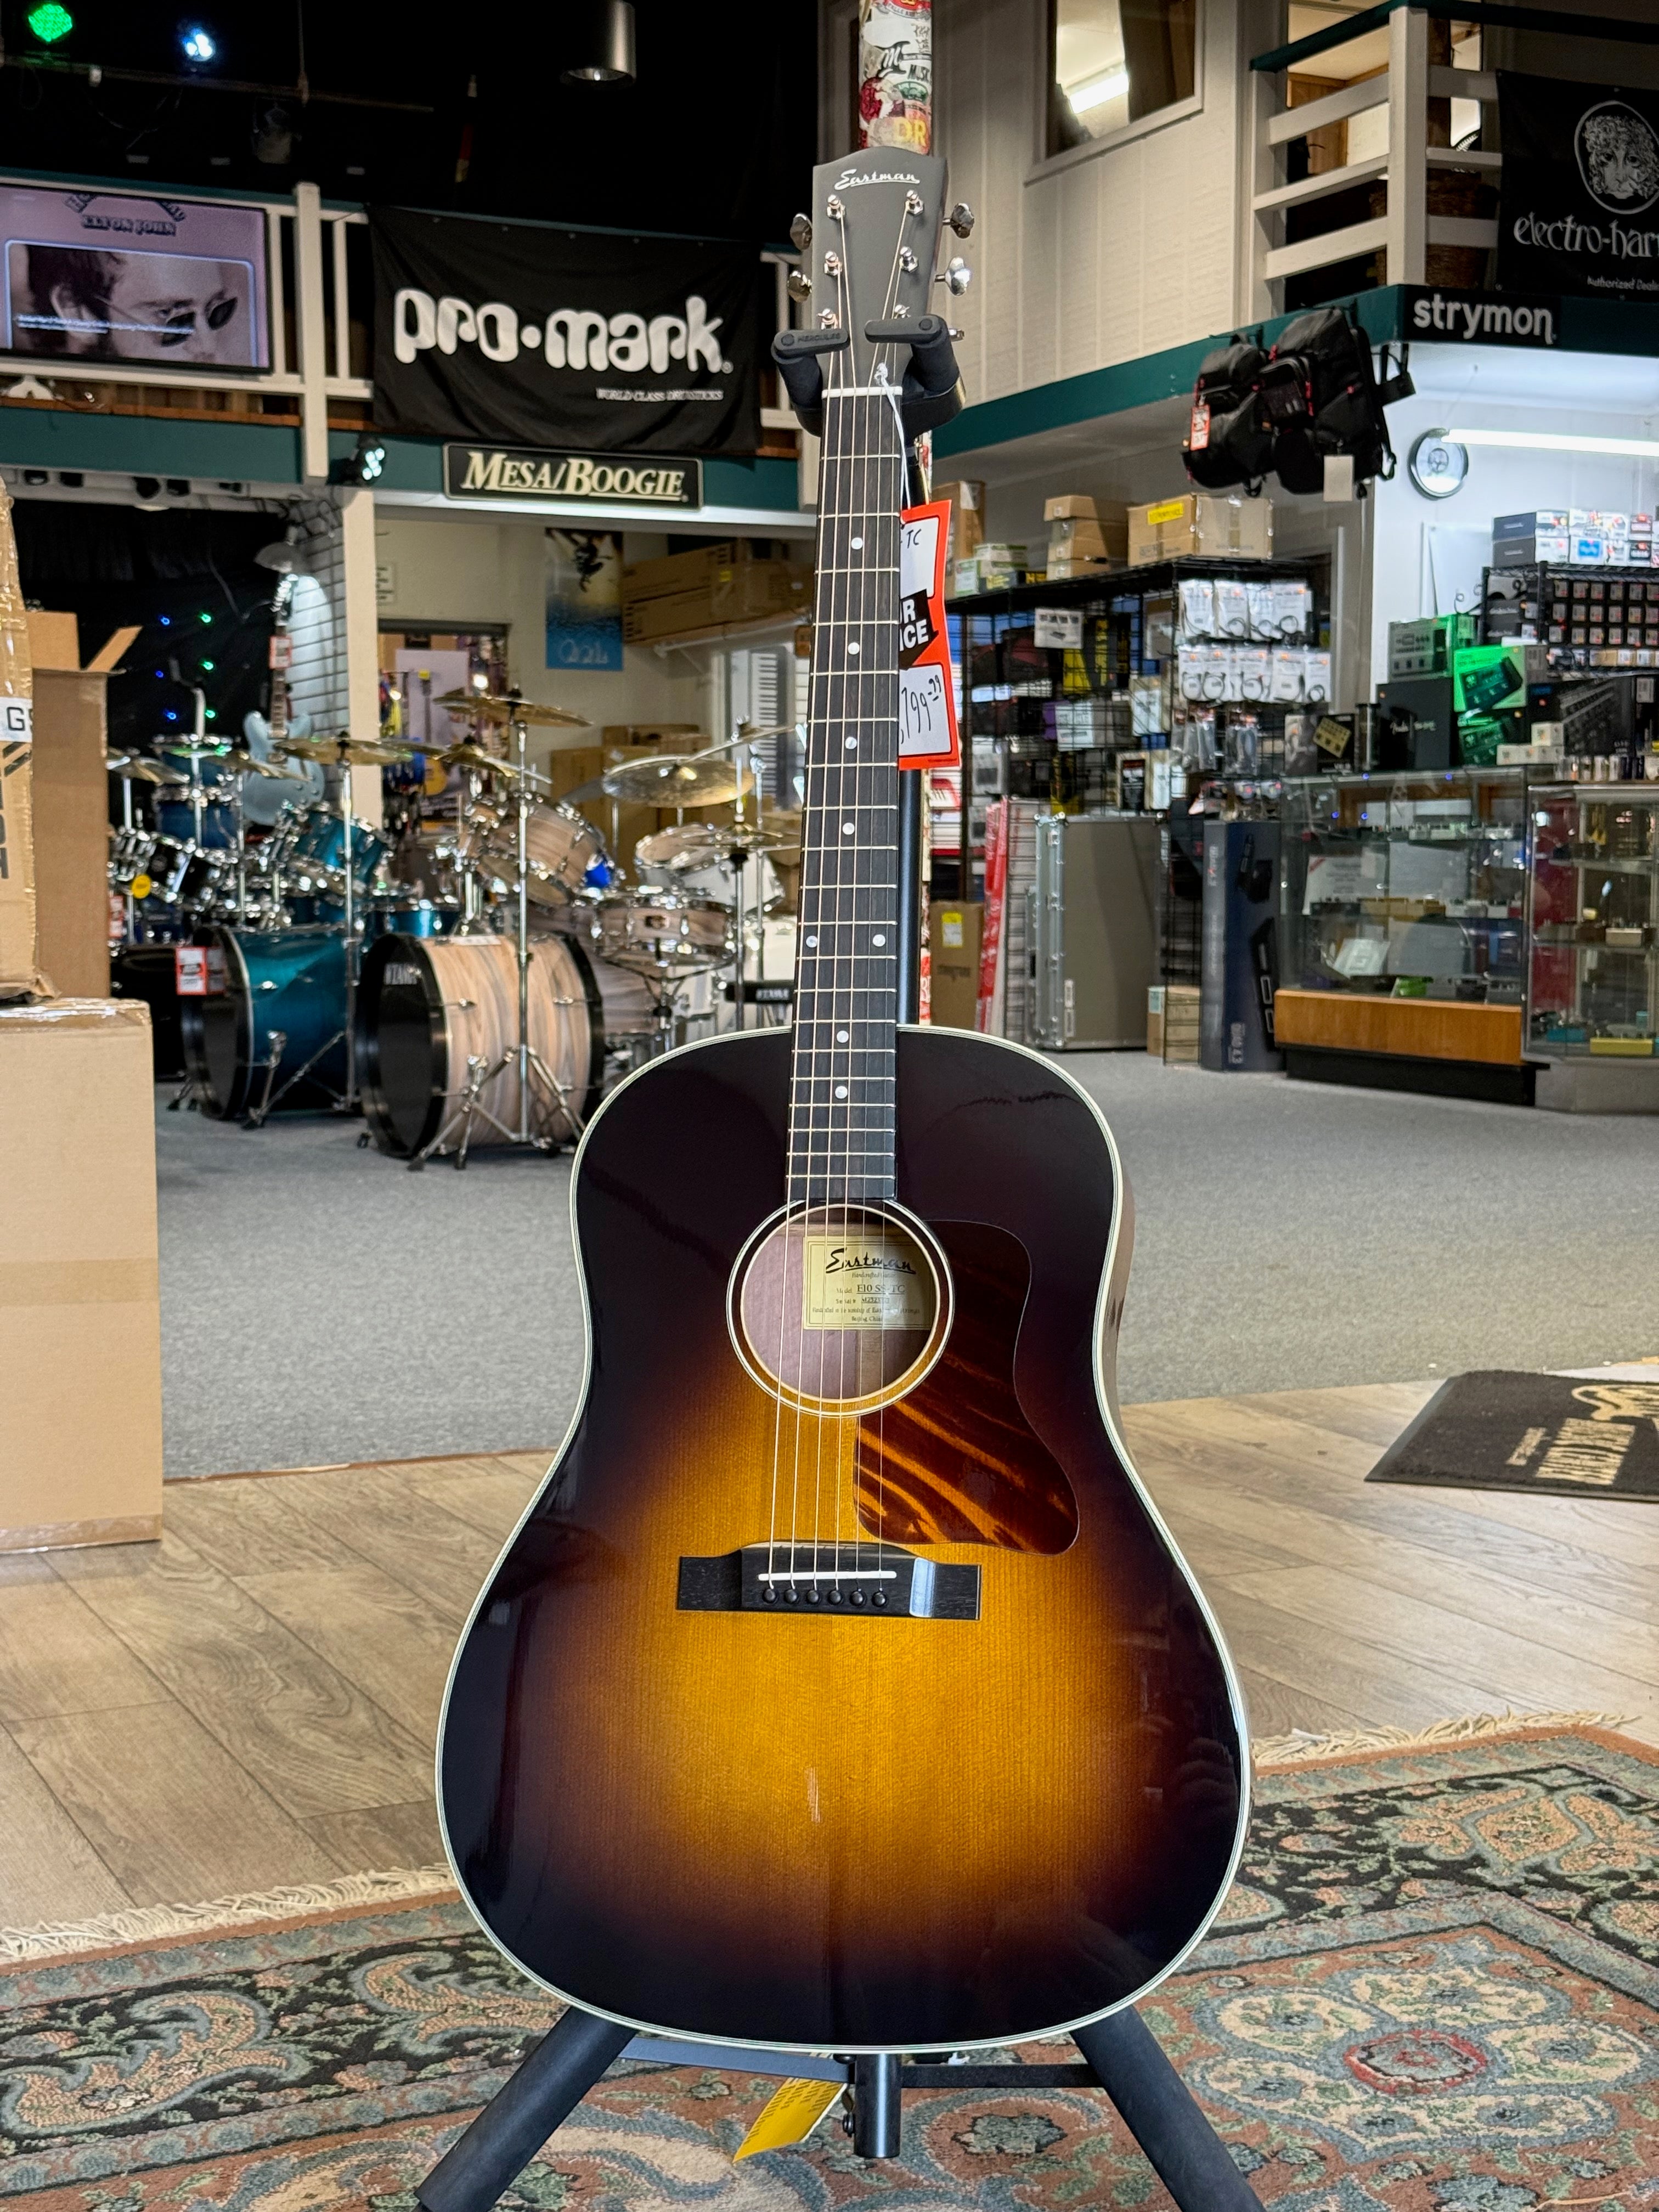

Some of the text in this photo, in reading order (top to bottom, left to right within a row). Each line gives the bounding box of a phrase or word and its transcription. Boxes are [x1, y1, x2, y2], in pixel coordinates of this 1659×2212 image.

[895, 117, 927, 147] DR
[834, 168, 921, 190] Eastman
[1413, 292, 1554, 345] strymon
[596, 387, 633, 401] WORLD
[633, 390, 665, 402] CLASS
[856, 1284, 872, 1293] E10
